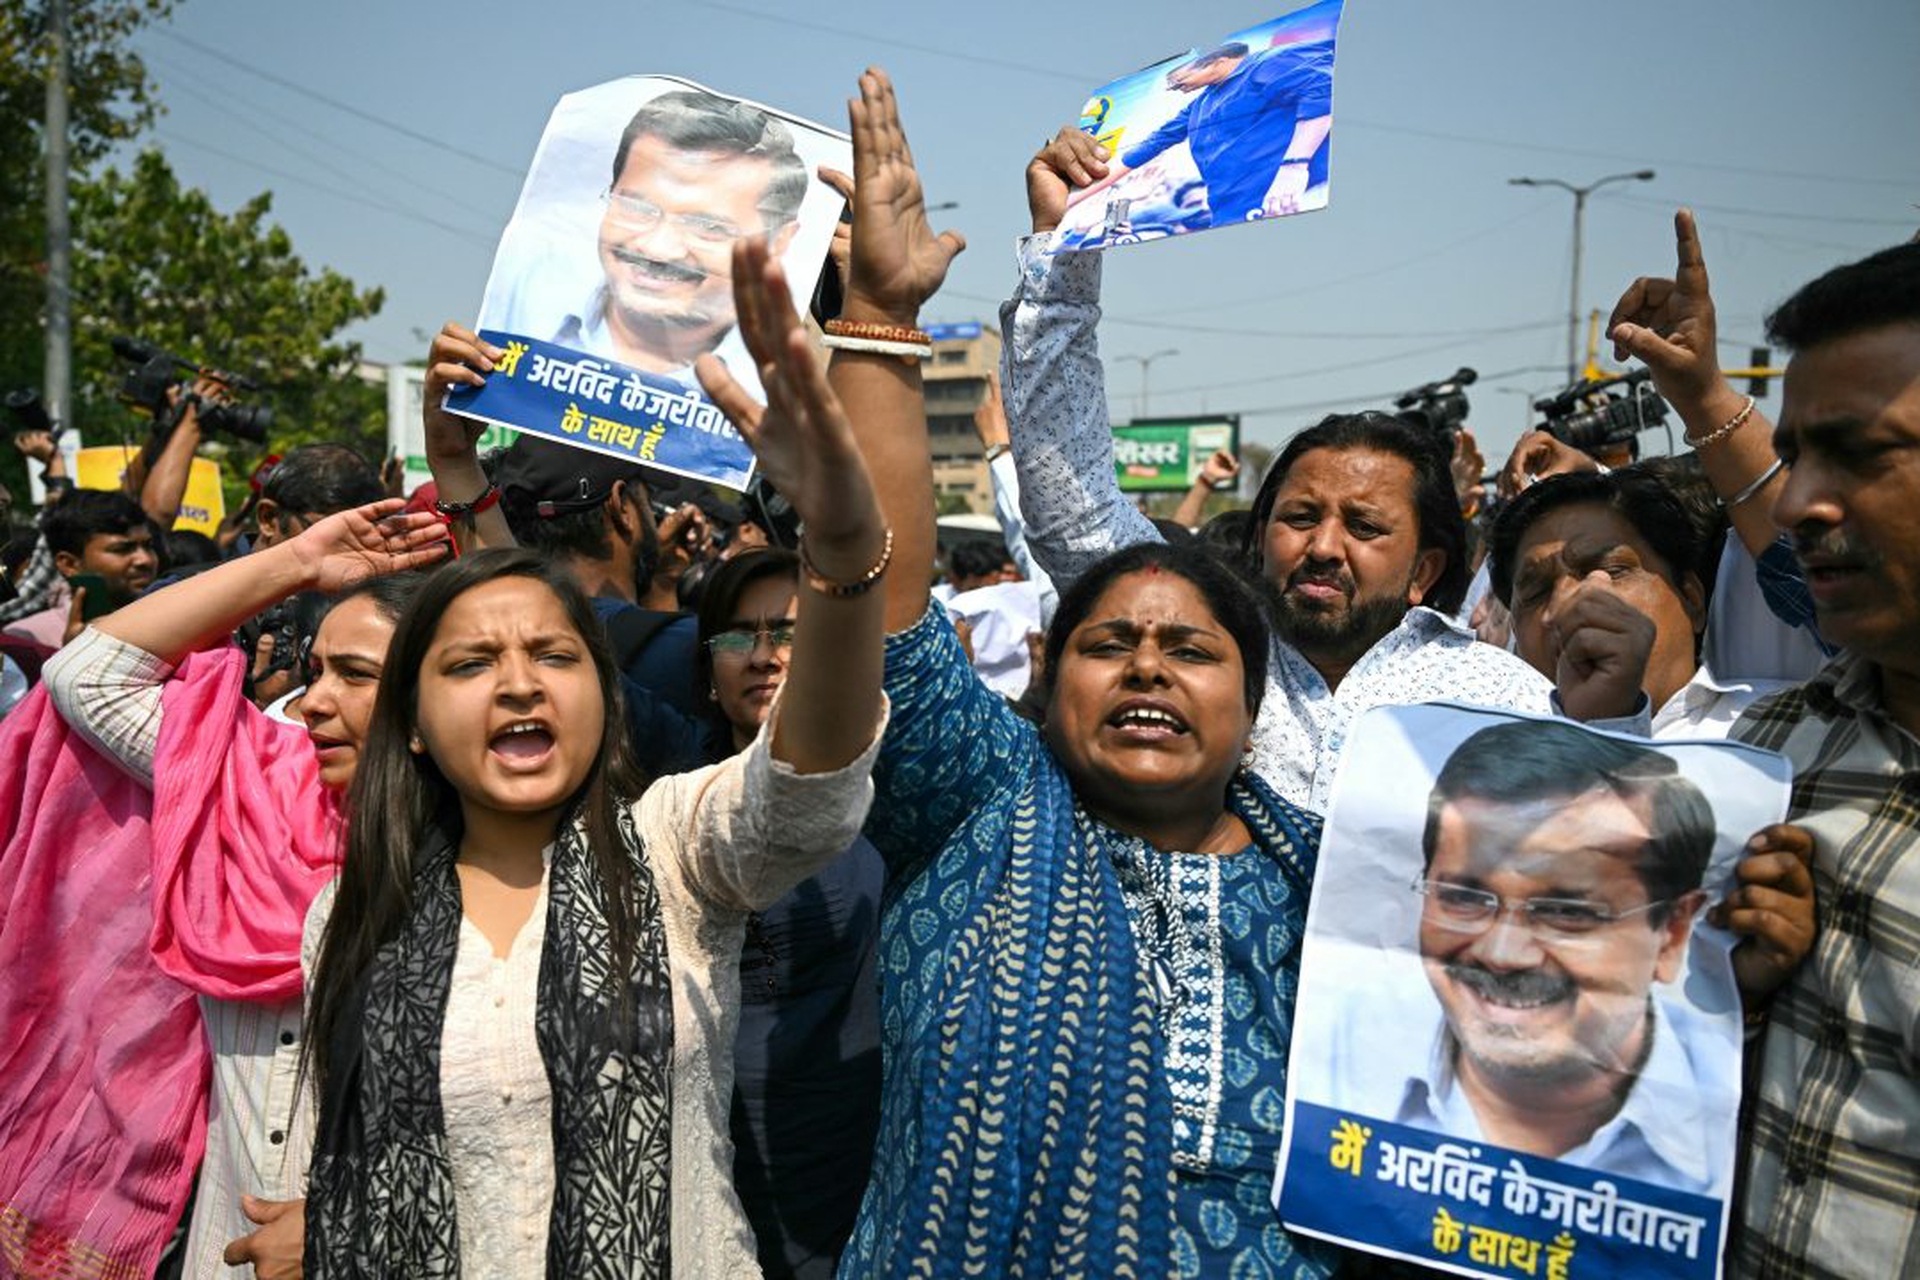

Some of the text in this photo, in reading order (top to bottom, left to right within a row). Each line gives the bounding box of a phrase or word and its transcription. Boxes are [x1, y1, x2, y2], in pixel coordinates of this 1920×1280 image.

[493, 340, 530, 378] मैं
[527, 354, 620, 404] अरविंद
[560, 403, 666, 461] के साथ हूँ
[1329, 1119, 1706, 1259] मैं अरविंद केजरीवाल
[1432, 1208, 1464, 1254] के
[1468, 1226, 1541, 1276] साथ
